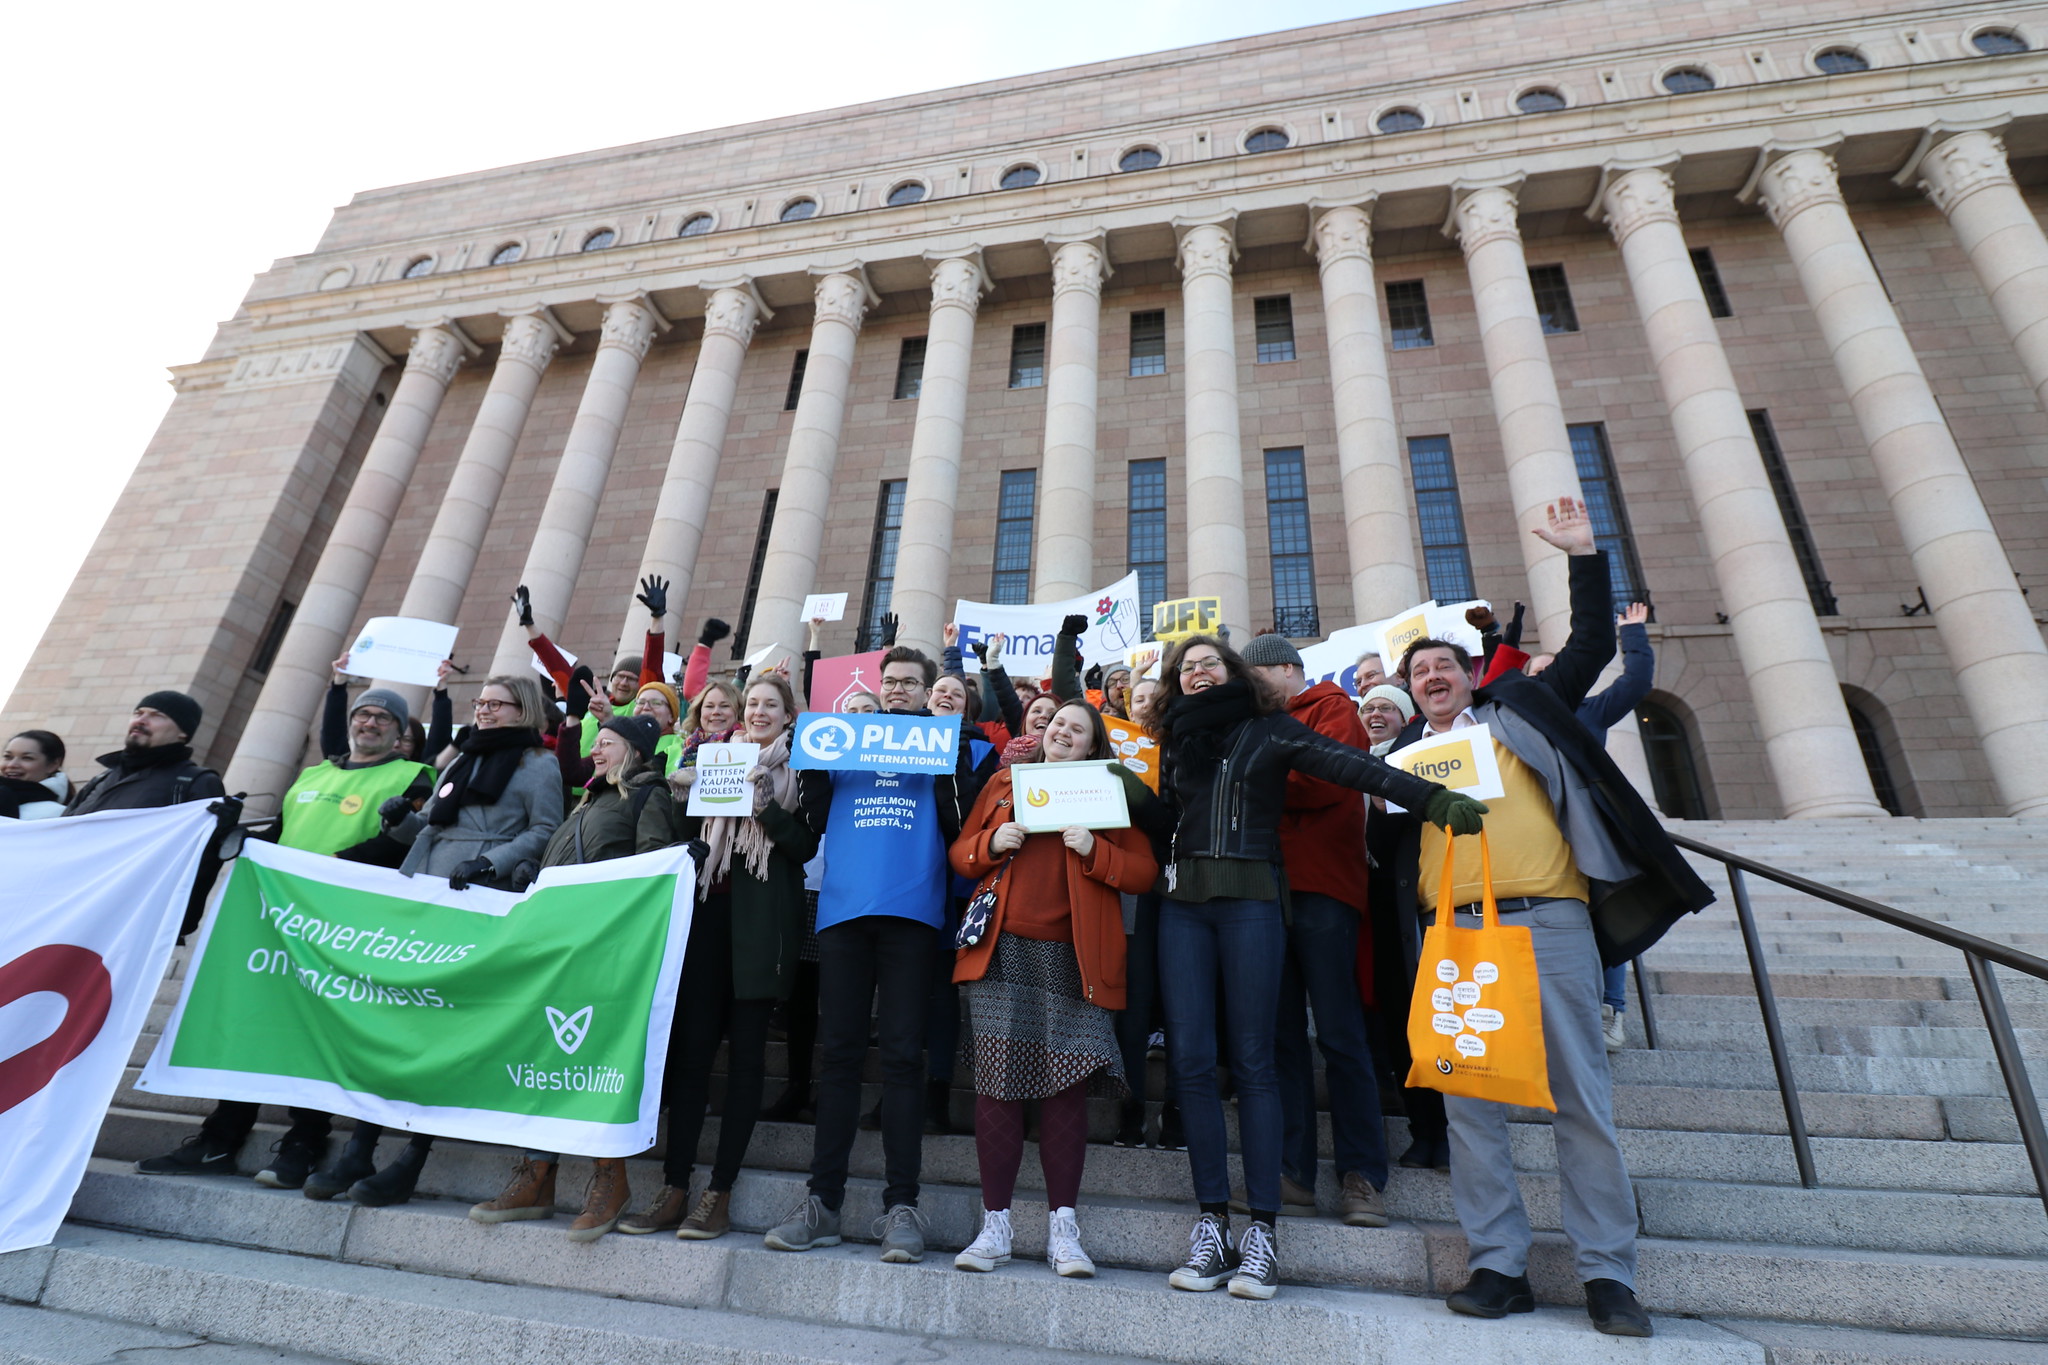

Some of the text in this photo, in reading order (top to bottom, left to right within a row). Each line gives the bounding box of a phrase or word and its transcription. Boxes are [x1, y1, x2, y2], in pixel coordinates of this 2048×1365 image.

[1156, 600, 1217, 634] UFF
[1392, 627, 1420, 647] fingo
[861, 724, 953, 753] PLAN
[860, 754, 949, 767] INTERNATIONAL
[1412, 759, 1462, 778] fingo
[702, 768, 746, 777] EETTISEN
[700, 777, 744, 786] KAUPAN
[875, 779, 899, 788] Plan
[699, 787, 744, 795] PUOLESTA
[854, 806, 914, 818] PUHTAASTA
[247, 948, 289, 975] on
[506, 1063, 625, 1094] Väestöliitto
